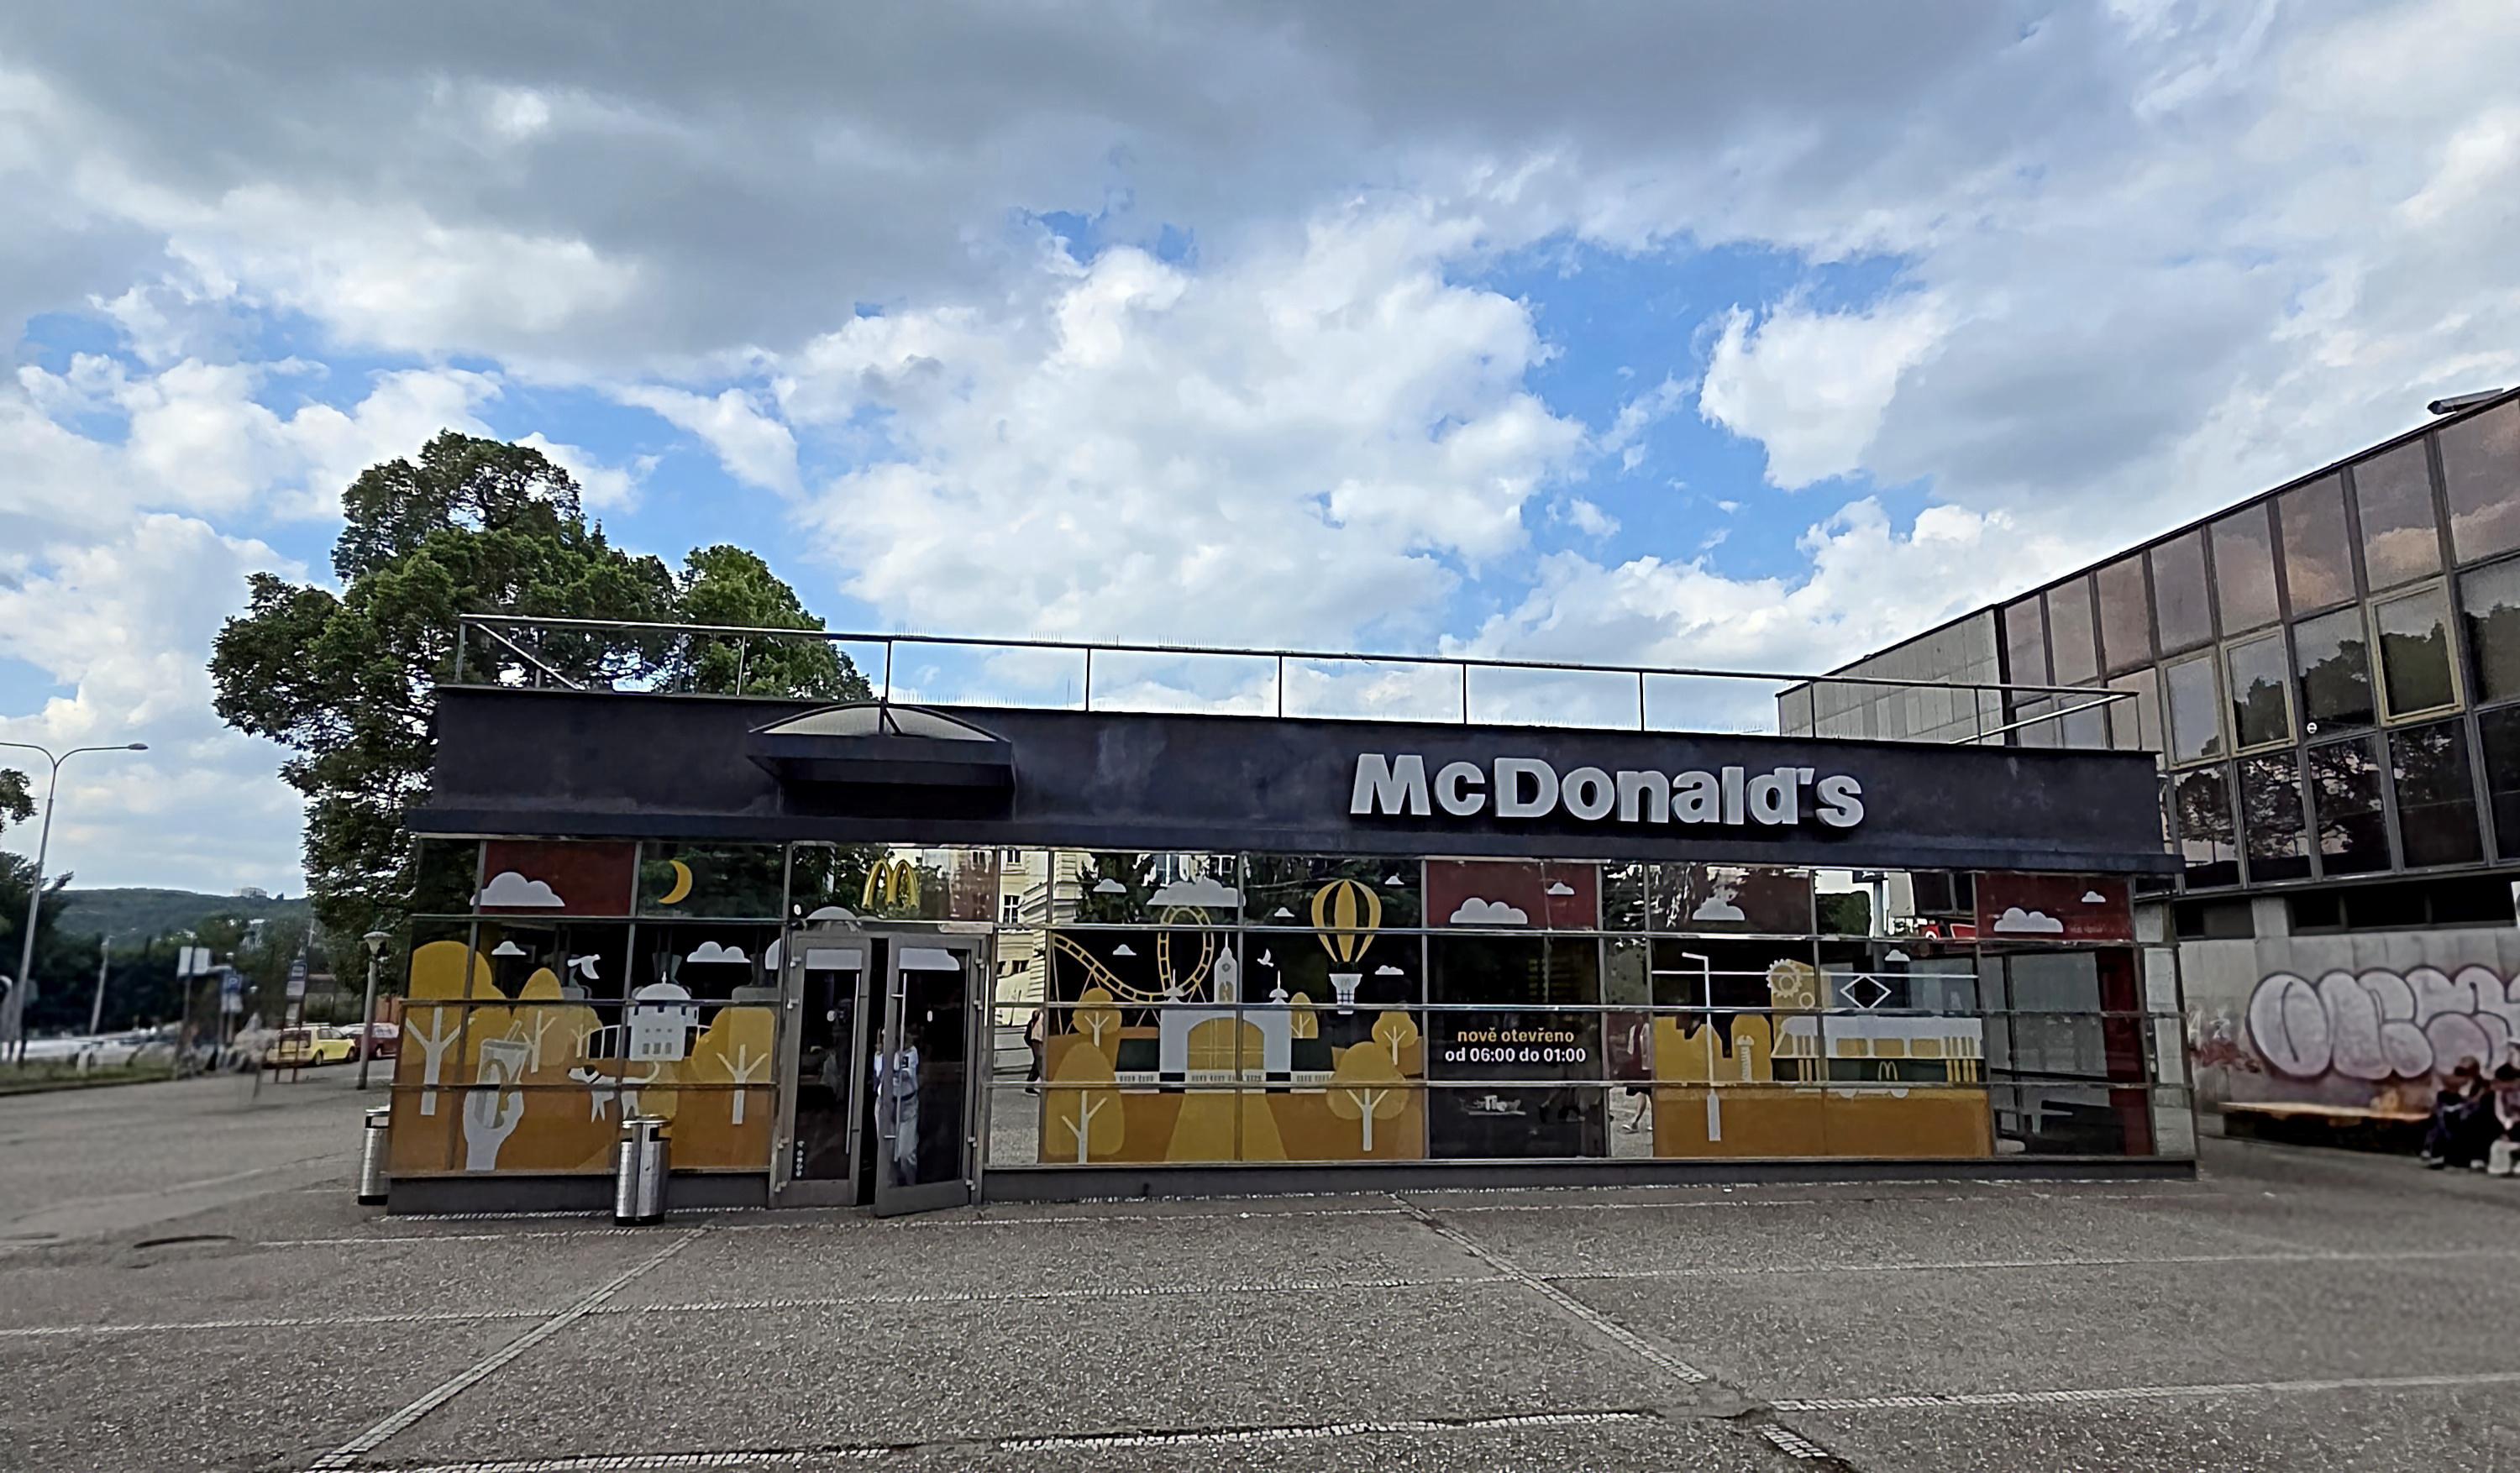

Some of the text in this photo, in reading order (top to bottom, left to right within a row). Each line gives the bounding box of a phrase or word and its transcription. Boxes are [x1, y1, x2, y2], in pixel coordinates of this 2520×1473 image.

[1350, 752, 1864, 827] McDonald's
[1457, 1027, 1574, 1042] nově otevřeno
[1445, 1046, 1586, 1062] od 06:00 do 01:00
